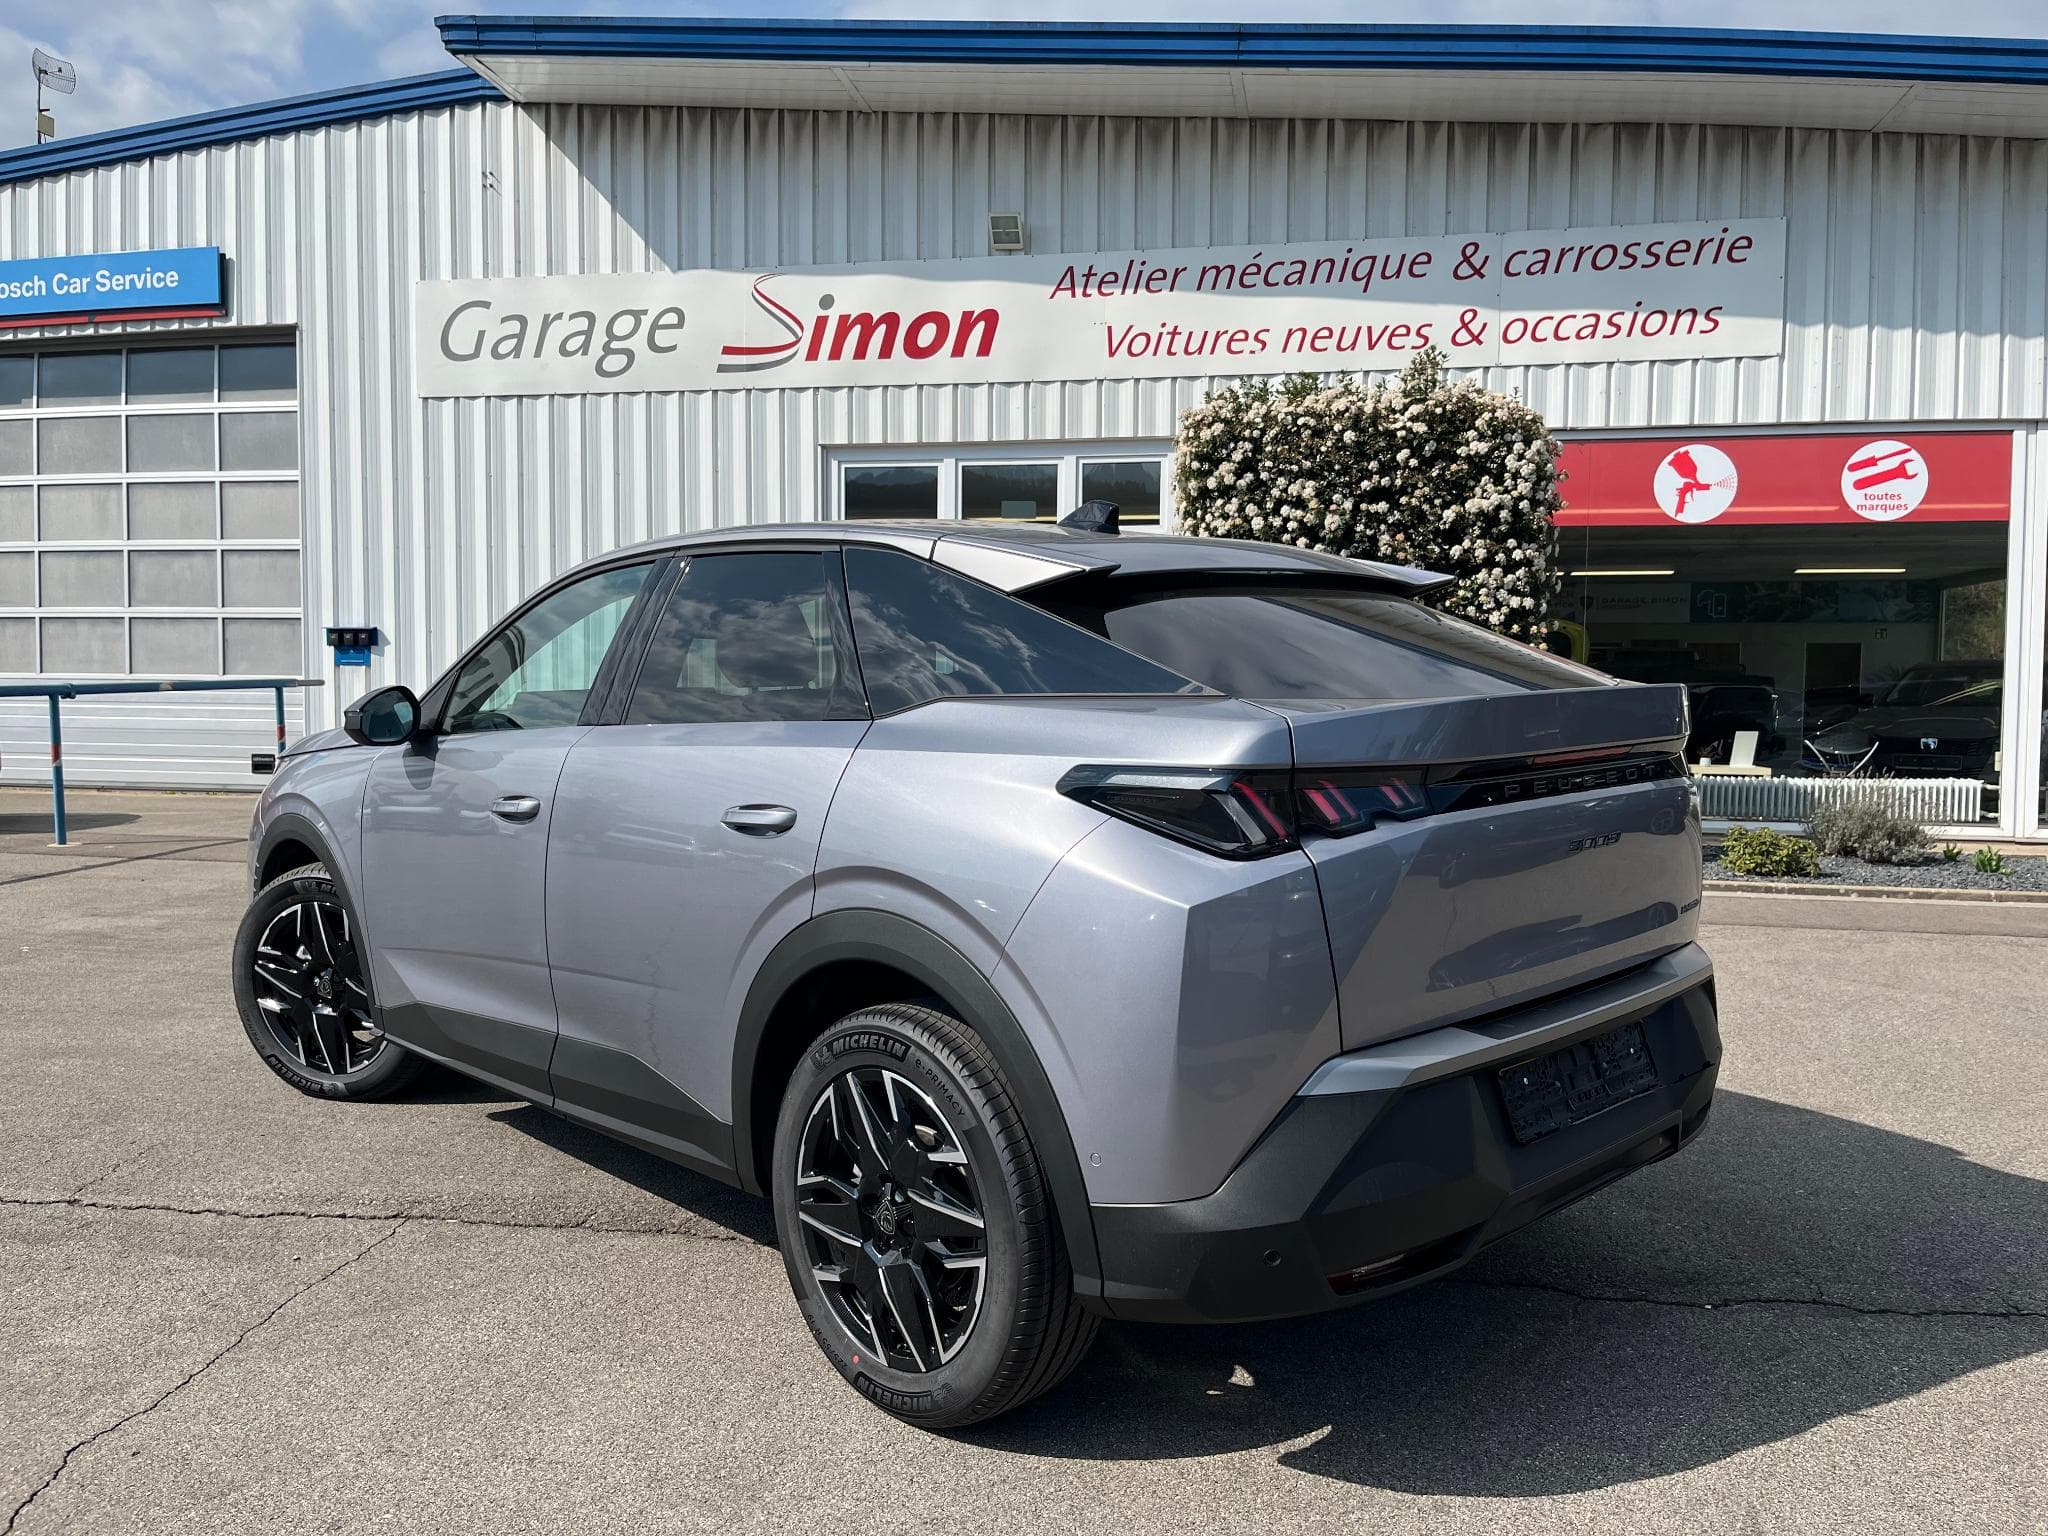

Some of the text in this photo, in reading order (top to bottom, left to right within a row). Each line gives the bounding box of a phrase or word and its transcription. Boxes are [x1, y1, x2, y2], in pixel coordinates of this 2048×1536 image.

[1048, 226, 1754, 300] Atelier mécanique & carrosserie
[0, 267, 179, 299] osch Car Service
[439, 272, 1000, 379] Garage Simon
[1105, 300, 1723, 358] Voitures neuves & occasions
[1856, 502, 1909, 514] marques
[1863, 492, 1903, 501] toutes
[1504, 764, 1656, 799] PEUGEOT
[832, 1034, 906, 1057] MICHELIN
[856, 1375, 933, 1412] MICHELIN
